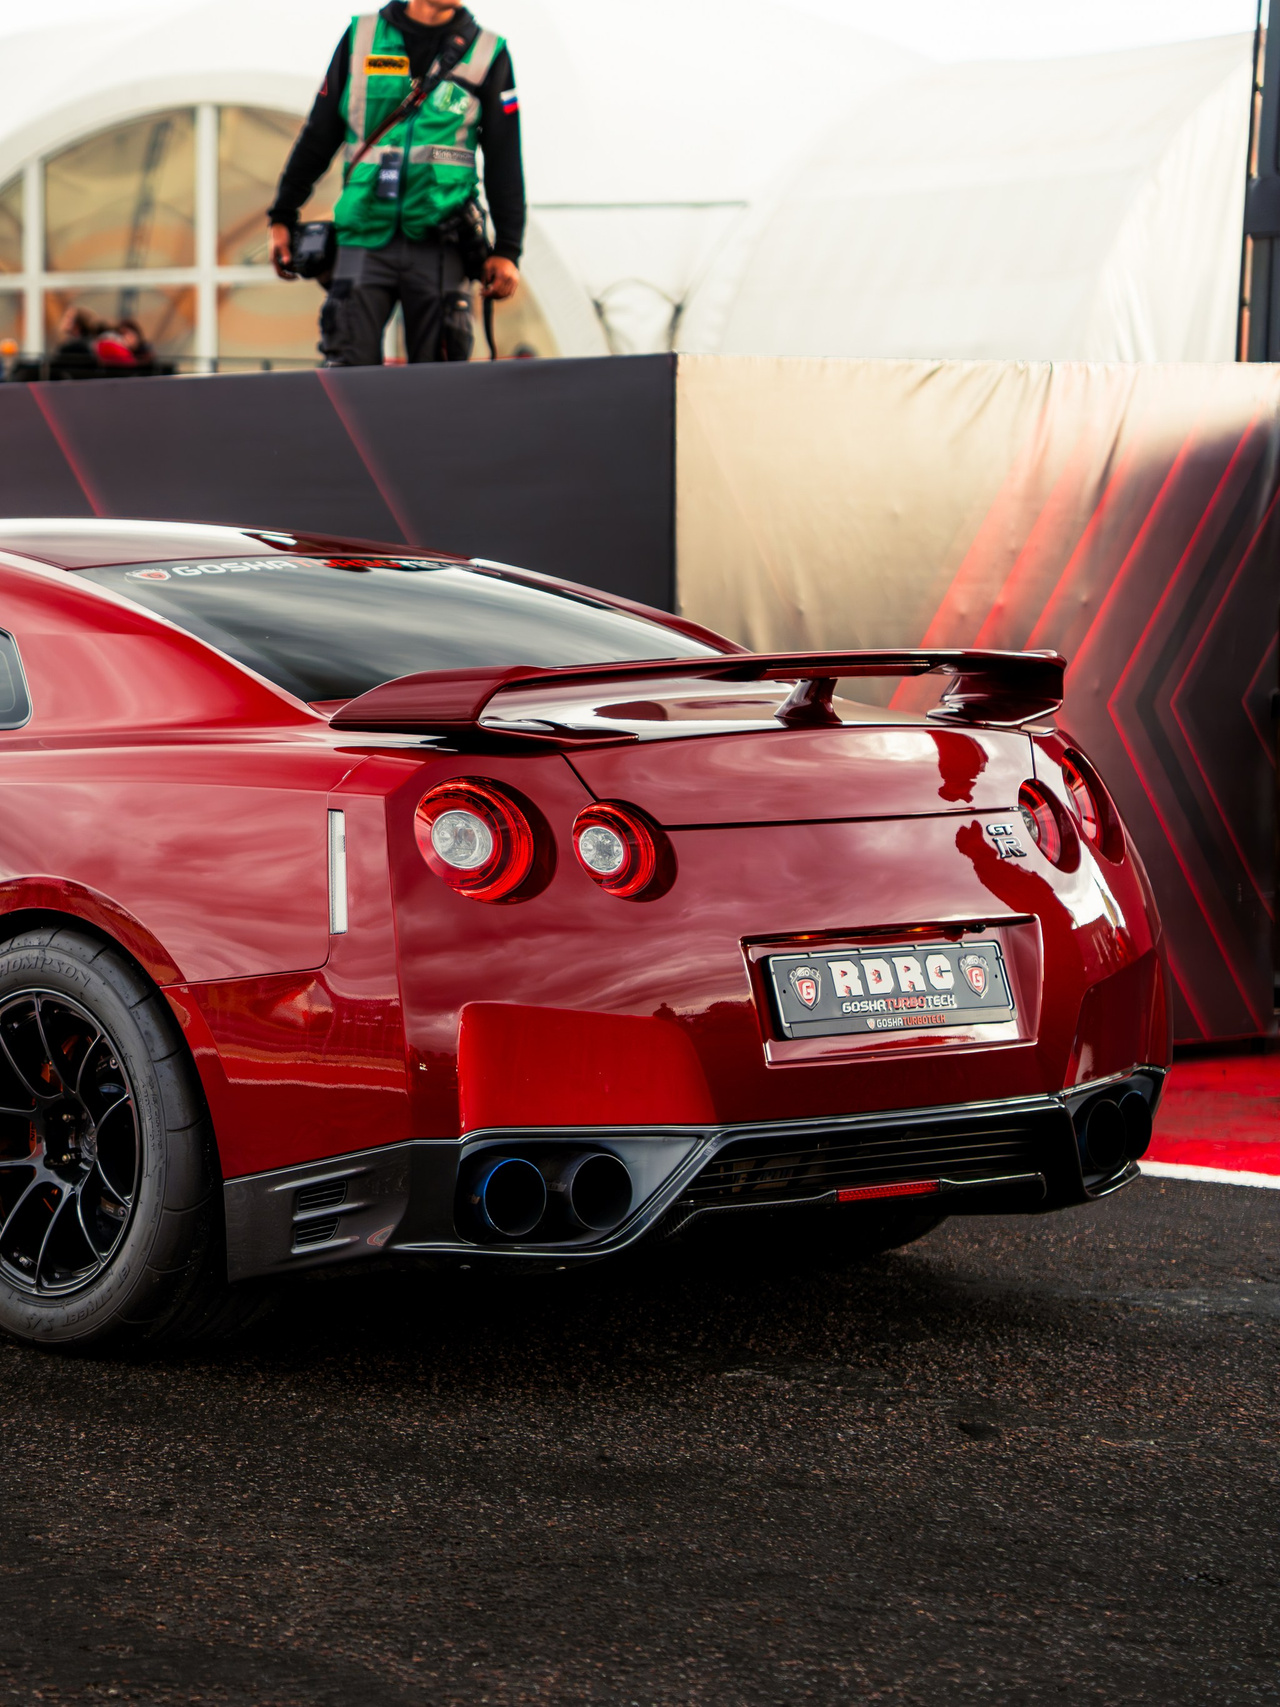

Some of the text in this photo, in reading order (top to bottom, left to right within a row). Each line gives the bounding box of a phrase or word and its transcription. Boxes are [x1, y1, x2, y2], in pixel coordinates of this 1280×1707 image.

[827, 954, 955, 998] RDRC
[842, 994, 957, 1014] GOSHATURBOTECH
[876, 1014, 946, 1028] GOSHATURBOTECH
